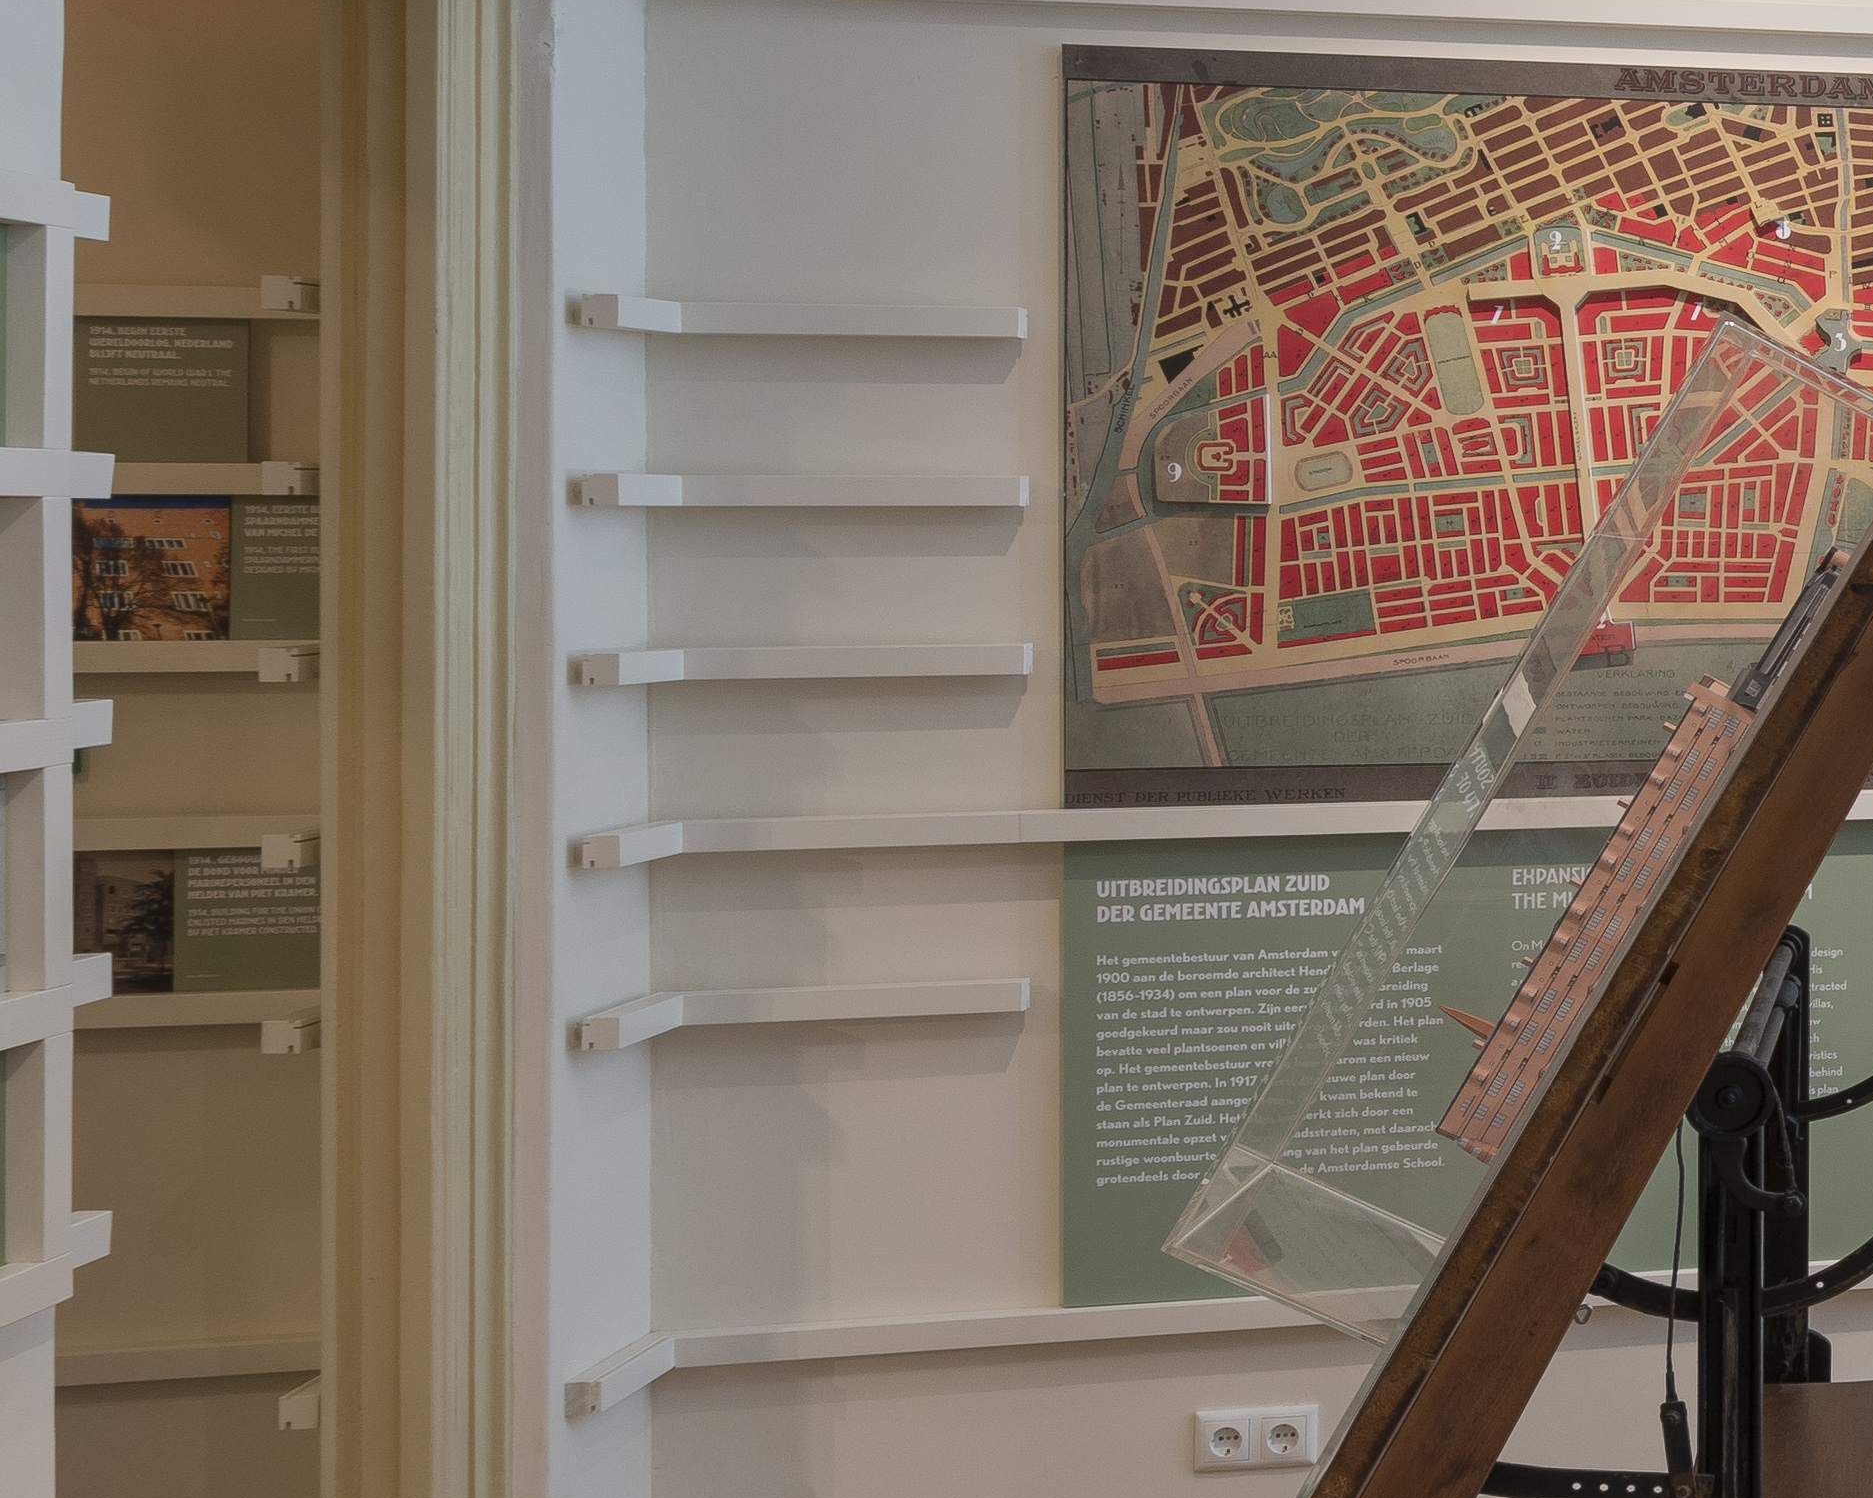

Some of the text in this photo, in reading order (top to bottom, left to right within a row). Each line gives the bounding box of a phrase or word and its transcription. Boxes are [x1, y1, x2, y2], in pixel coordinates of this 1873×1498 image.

[1549, 230, 1562, 250] 2
[1114, 383, 1136, 433] SCHINKEL
[1149, 376, 1193, 419] SPOORBAAN
[1167, 462, 1182, 482] 9
[1392, 652, 1450, 666] SPOORBAAN
[1596, 669, 1675, 679] VERKLARING
[1222, 713, 1476, 729] UITBREIDINGSPLAN ZUID
[1333, 731, 1370, 743] DER
[1065, 787, 1347, 804] DIENST DER PUBLIEKE WERKEN
[1096, 874, 1330, 896] UITBREIDINGSPLAN ZUID
[1097, 898, 1365, 922] DER GEMEENTE AMSTERDAM
[1512, 893, 1547, 909] THE
[1096, 955, 1119, 965] Het
[1122, 952, 1230, 966] gemeentebestuur
[1257, 948, 1328, 959] Amsterdam
[1406, 944, 1442, 954] maart
[1511, 940, 1843, 960] On design
[1096, 962, 1439, 983] 1900 aan de beroemde architect Berlage
[1096, 989, 1175, 1002] (1856-1934)
[1225, 986, 1252, 999] plan
[1284, 984, 1300, 994] de
[1121, 1008, 1137, 1019] de
[1140, 1007, 1167, 1018] stad
[1170, 1008, 1182, 1017] te
[1185, 1007, 1254, 1016] ontwerpen.
[1257, 1002, 1281, 1015] Zijn
[1386, 999, 1398, 1008] in
[1400, 996, 1432, 1007] 1905
[1096, 1025, 1178, 1040] goedgekeurd
[1241, 1022, 1272, 1032] nooit
[1393, 1015, 1414, 1025] Het
[1417, 1014, 1443, 1027] plan
[1096, 1046, 1142, 1056] bevatte
[1145, 1043, 1170, 1054] veel
[1174, 1043, 1248, 1054] plantsoenen
[1250, 1042, 1265, 1050] en
[1379, 1033, 1418, 1044] kritiek
[1096, 1052, 1430, 1076] op. Het gemeentebestuur een nieuw
[1096, 1070, 1416, 1095] plan te ontwerpen. In 1917 plan door
[1816, 1085, 1838, 1095] plan
[1096, 1087, 1418, 1111] de Gemeenteraad kwam bekend te
[1096, 1106, 1413, 1129] staan als Plan Zuid. zich door een
[1096, 1125, 1386, 1147] monumentale opzet met
[1096, 1155, 1140, 1166] rustige
[1330, 1144, 1349, 1153] het
[1352, 1142, 1378, 1155] plan
[1380, 1139, 1438, 1153] gebeurde
[1096, 1156, 1445, 1186] grotendeels door de Amsterdamse School.
